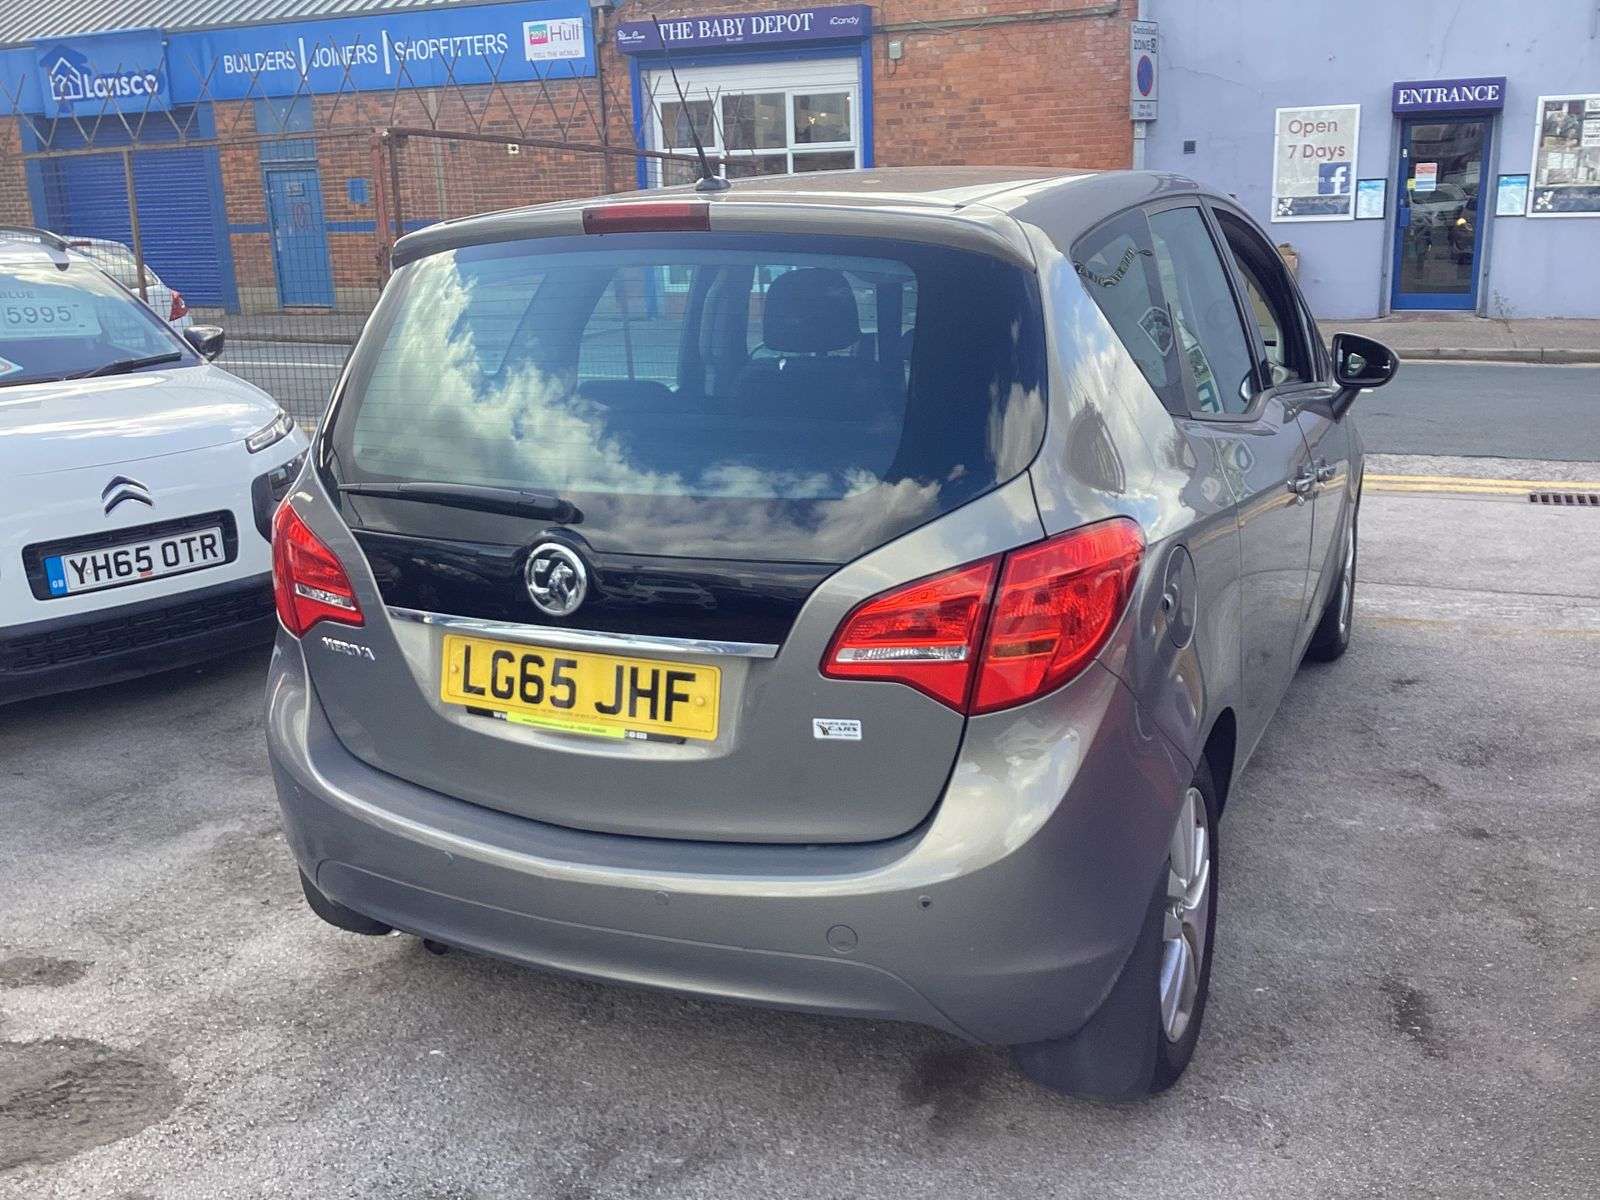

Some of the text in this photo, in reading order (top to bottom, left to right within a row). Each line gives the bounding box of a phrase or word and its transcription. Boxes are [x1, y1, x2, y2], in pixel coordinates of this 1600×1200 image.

[550, 23, 580, 41] Hull
[658, 13, 814, 41] THE BABY DEPOT
[223, 33, 508, 74] BUILDERS JOINERS SHOPFITTERS
[1398, 85, 1500, 105] ENTRANCE
[1288, 120, 1338, 138] Open
[1288, 144, 1346, 161] 7 Days
[69, 533, 219, 585] YH65 OTR
[462, 644, 697, 722] LG65 JHF
